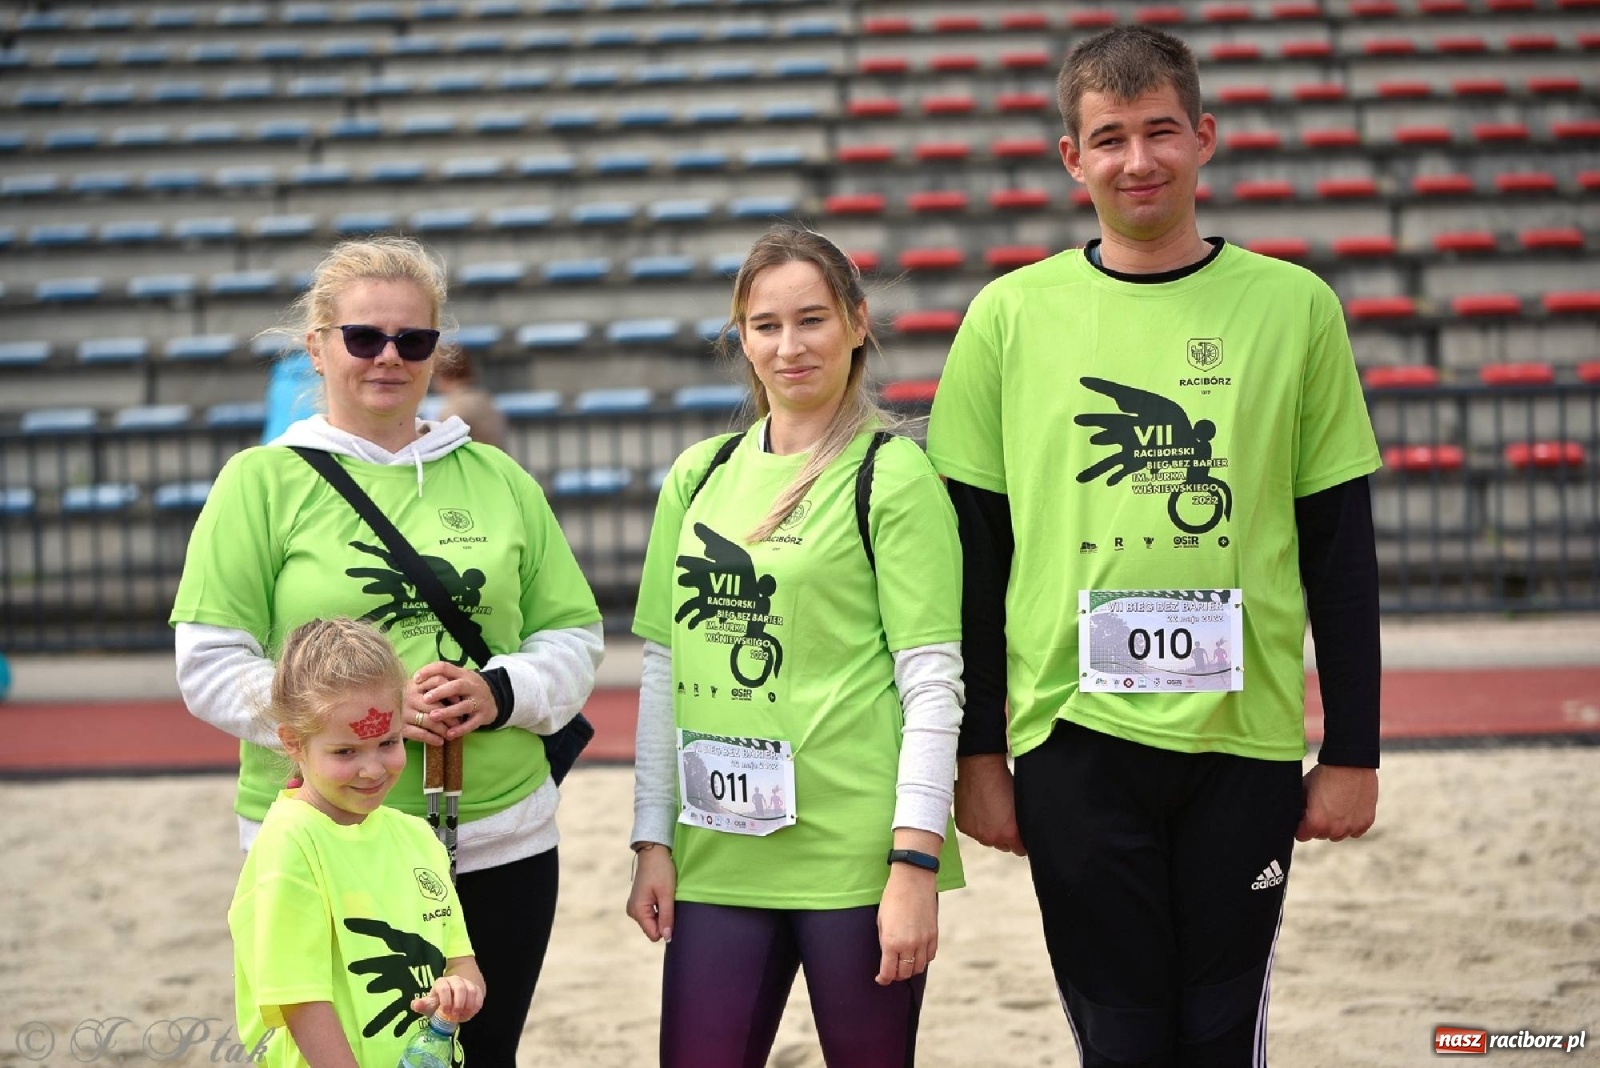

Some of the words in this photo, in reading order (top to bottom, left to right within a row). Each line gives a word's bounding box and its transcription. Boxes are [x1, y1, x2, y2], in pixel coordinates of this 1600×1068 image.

[1179, 376, 1231, 387] RACIBÓRZ
[1133, 424, 1172, 446] VII
[1133, 447, 1195, 458] RACIBORSKI
[1146, 460, 1169, 470] BIEG
[1171, 459, 1191, 468] BEZ
[1193, 458, 1229, 468] BARIER
[1152, 471, 1186, 482] JURKA
[1132, 482, 1219, 494] WIŚNIEWSKIEGO
[1191, 496, 1219, 505] 2022
[1114, 537, 1124, 547] R
[709, 572, 741, 596] VII
[707, 596, 756, 609] RACIBORSKI
[1126, 602, 1153, 612] BIEG
[1156, 602, 1179, 612] BEZ
[1182, 601, 1224, 612] BARIER
[716, 610, 735, 620] BIEG
[737, 612, 751, 621] BEZ
[752, 614, 784, 626] BARIER
[719, 622, 747, 633] JURKA
[705, 632, 771, 648] WIŚNIEWSKIEGO
[1127, 628, 1193, 660] 010
[710, 770, 748, 803] 011
